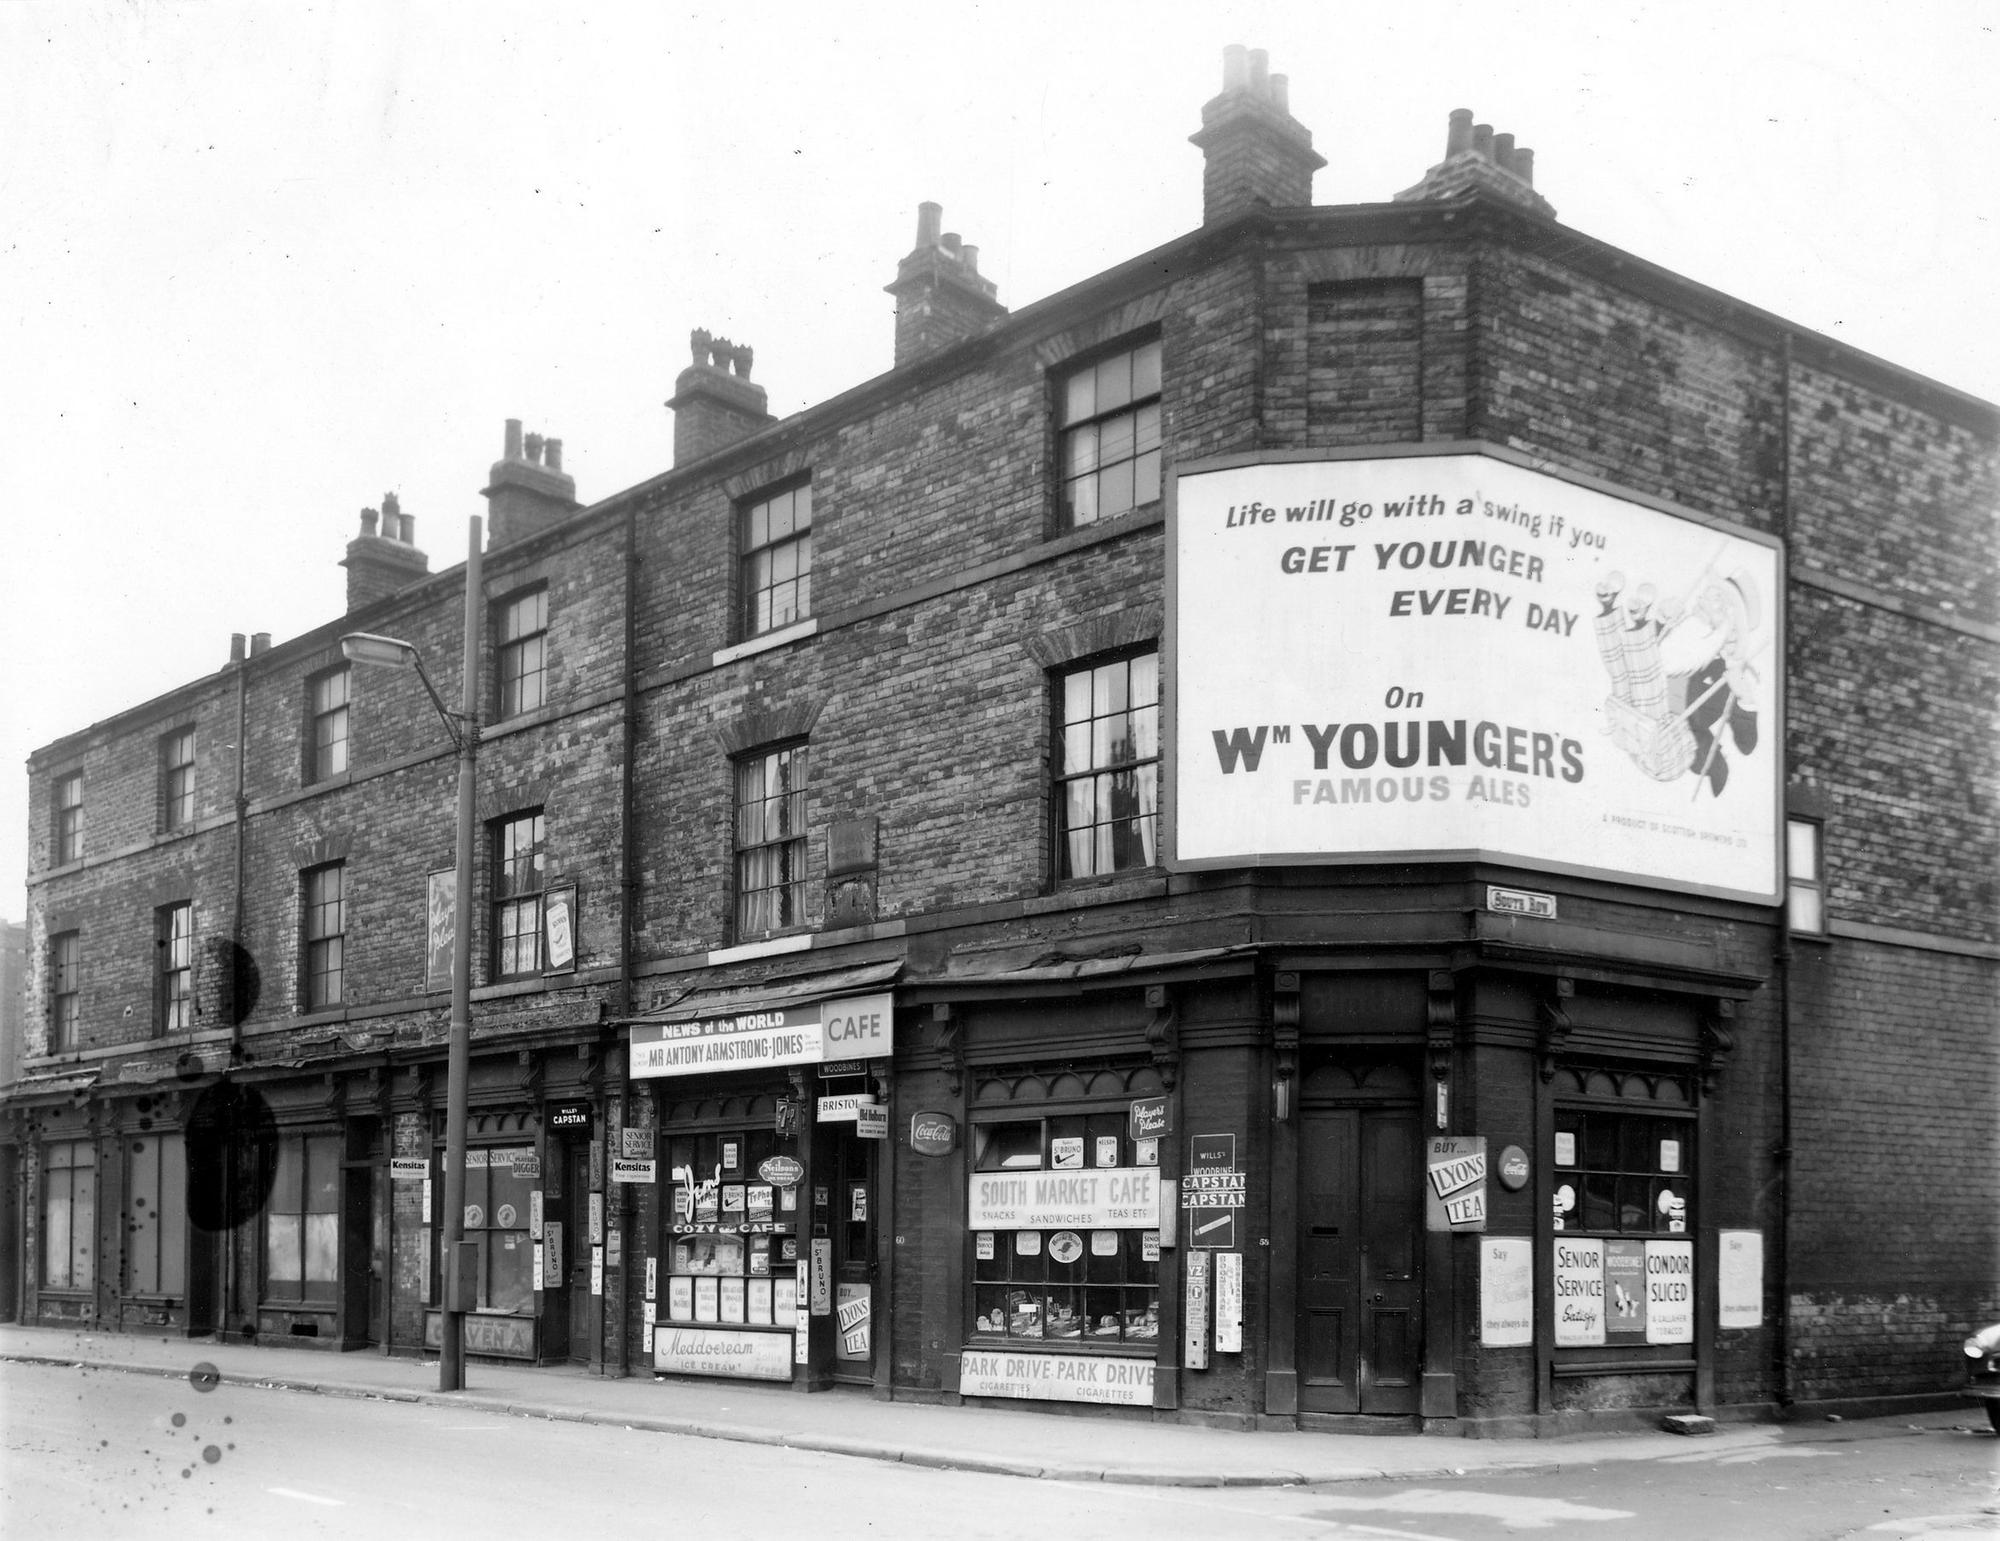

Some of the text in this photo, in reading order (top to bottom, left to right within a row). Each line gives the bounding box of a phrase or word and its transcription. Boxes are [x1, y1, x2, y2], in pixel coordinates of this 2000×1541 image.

[1226, 494, 1606, 550] Life will go with a swing if you
[1281, 540, 1544, 582] GET YOUNGER
[1389, 589, 1579, 636] EVERY DAY
[1385, 686, 1424, 709] On
[1302, 720, 1584, 784] YOUNGER'S
[1293, 775, 1531, 809] FAMOUS ALES
[662, 1012, 784, 1039] NEWS of the WORLD
[828, 1013, 881, 1042] CAFE
[649, 1049, 663, 1067] MR
[666, 1044, 704, 1066] ANTONY
[706, 1034, 803, 1063] ARMSTRONG-JONES
[824, 1062, 861, 1073] WOODBINES
[553, 1114, 586, 1124] CAPSTAN
[1139, 1118, 1165, 1135] Please
[625, 1132, 652, 1141] SENIOR
[625, 1141, 652, 1149] SERVICE
[393, 1160, 425, 1169] Kensitas
[490, 1151, 513, 1164] SERVIC
[615, 1162, 651, 1172] Kensitas
[513, 1163, 540, 1173] DIGGER
[1436, 1155, 1484, 1191] LYONS
[981, 1173, 1150, 1207] SOUTH MARKET CAFÉ
[982, 1211, 1015, 1220] SNACKS
[1030, 1214, 1092, 1224] SANDWICHES
[1108, 1209, 1128, 1218] TEAS
[1451, 1195, 1483, 1220] TEA
[673, 1223, 715, 1234] COZY
[739, 1223, 786, 1233] CAFE
[550, 1237, 558, 1270] BRUNO
[1144, 1242, 1160, 1250] SERVIC
[1493, 1248, 1508, 1261] Say
[1558, 1246, 1599, 1268] SENIOR
[1647, 1255, 1691, 1274] CONDOR
[816, 1257, 825, 1296] BRUNO
[1557, 1275, 1602, 1297] SERVICE
[1651, 1283, 1687, 1302] SLICED
[840, 1299, 868, 1327] LYONS
[1562, 1304, 1597, 1331] Satisfy
[848, 1332, 867, 1351] TEA
[701, 1361, 735, 1372] CREAM
[962, 1356, 1154, 1387] PARK DRIVE PARK DRIVE
[980, 1381, 1134, 1399] CIGARETTES CIGARETTES
